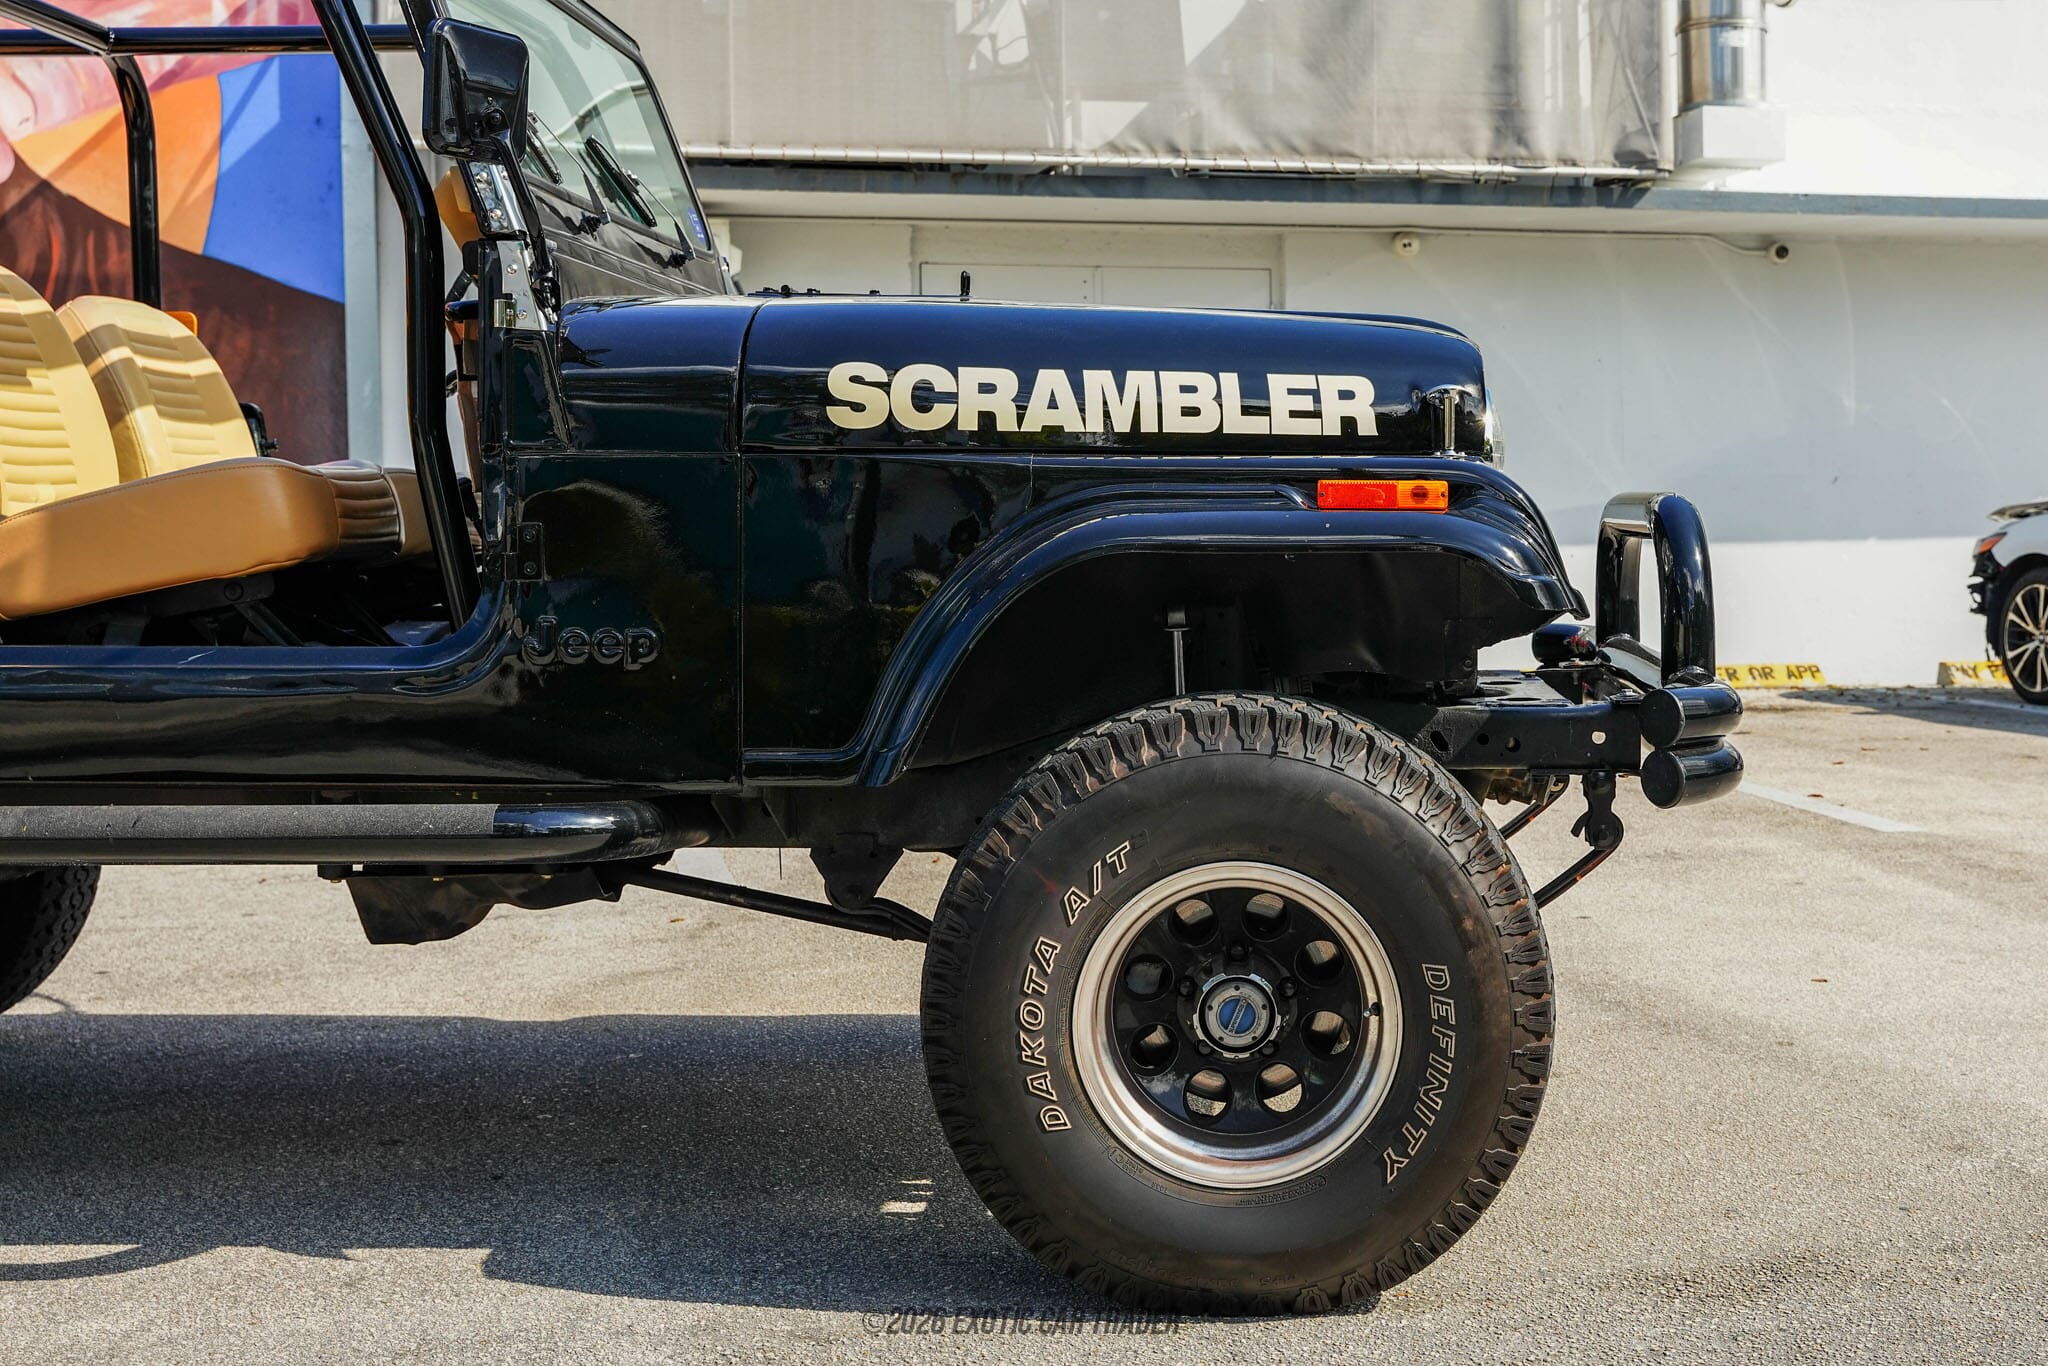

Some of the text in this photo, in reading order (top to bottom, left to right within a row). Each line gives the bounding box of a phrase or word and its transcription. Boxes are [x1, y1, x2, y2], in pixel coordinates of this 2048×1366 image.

[826, 361, 1378, 437] SCRAMBLER
[521, 615, 662, 671] Jeep
[1748, 665, 1776, 680] OR
[1786, 664, 1820, 680] APP
[1018, 935, 1073, 1132] DAKOTA
[1062, 840, 1132, 926] A/T
[1382, 963, 1457, 1185] DEFINITY
